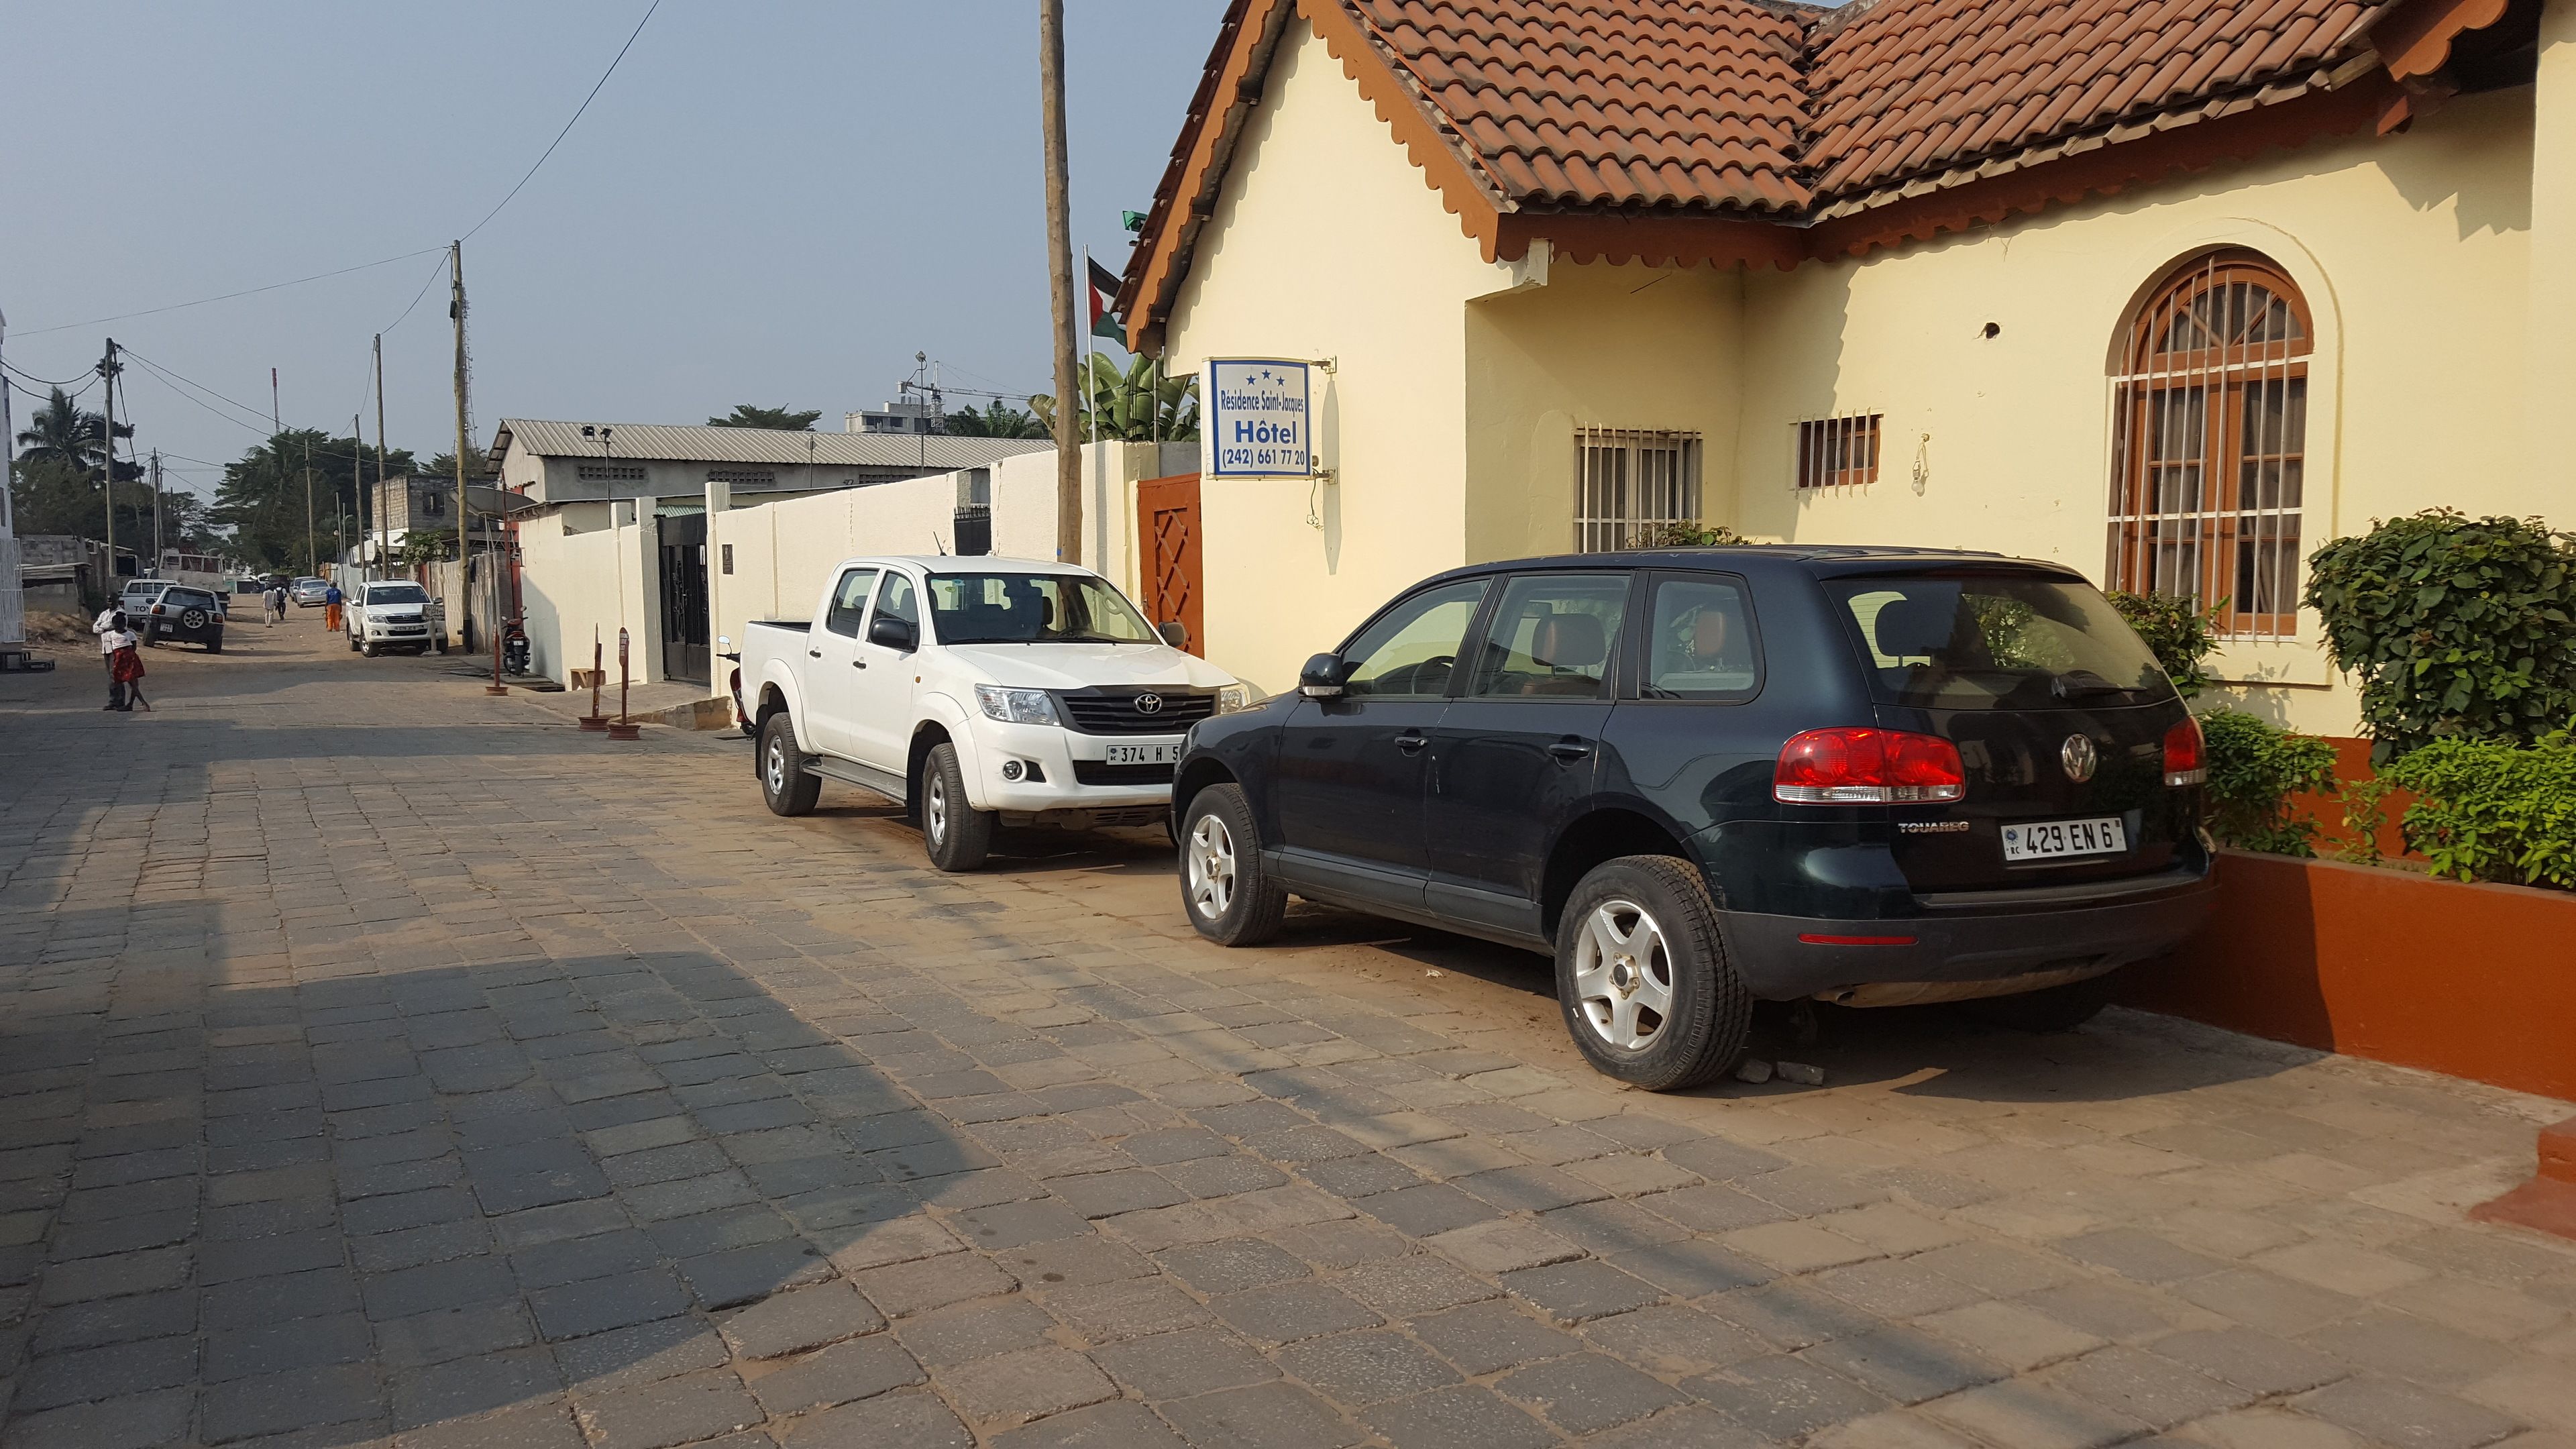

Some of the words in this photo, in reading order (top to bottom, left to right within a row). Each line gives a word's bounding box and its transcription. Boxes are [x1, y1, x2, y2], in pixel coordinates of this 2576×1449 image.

[1221, 389, 1259, 411] Résidence
[1261, 390, 1303, 417] Saint-Jacques
[1235, 419, 1297, 444] Hôtel
[1222, 449, 1254, 468] (242)
[1258, 449, 1277, 464] 661
[1281, 449, 1292, 465] 77
[1295, 450, 1305, 465] 20
[1121, 747, 1145, 762] 374
[1156, 747, 1162, 761] H
[1173, 746, 1179, 761] 5
[1898, 821, 1970, 833] TOUAREG
[2026, 826, 2064, 854] 429
[2069, 823, 2096, 851] EN
[2100, 822, 2112, 848] 6
